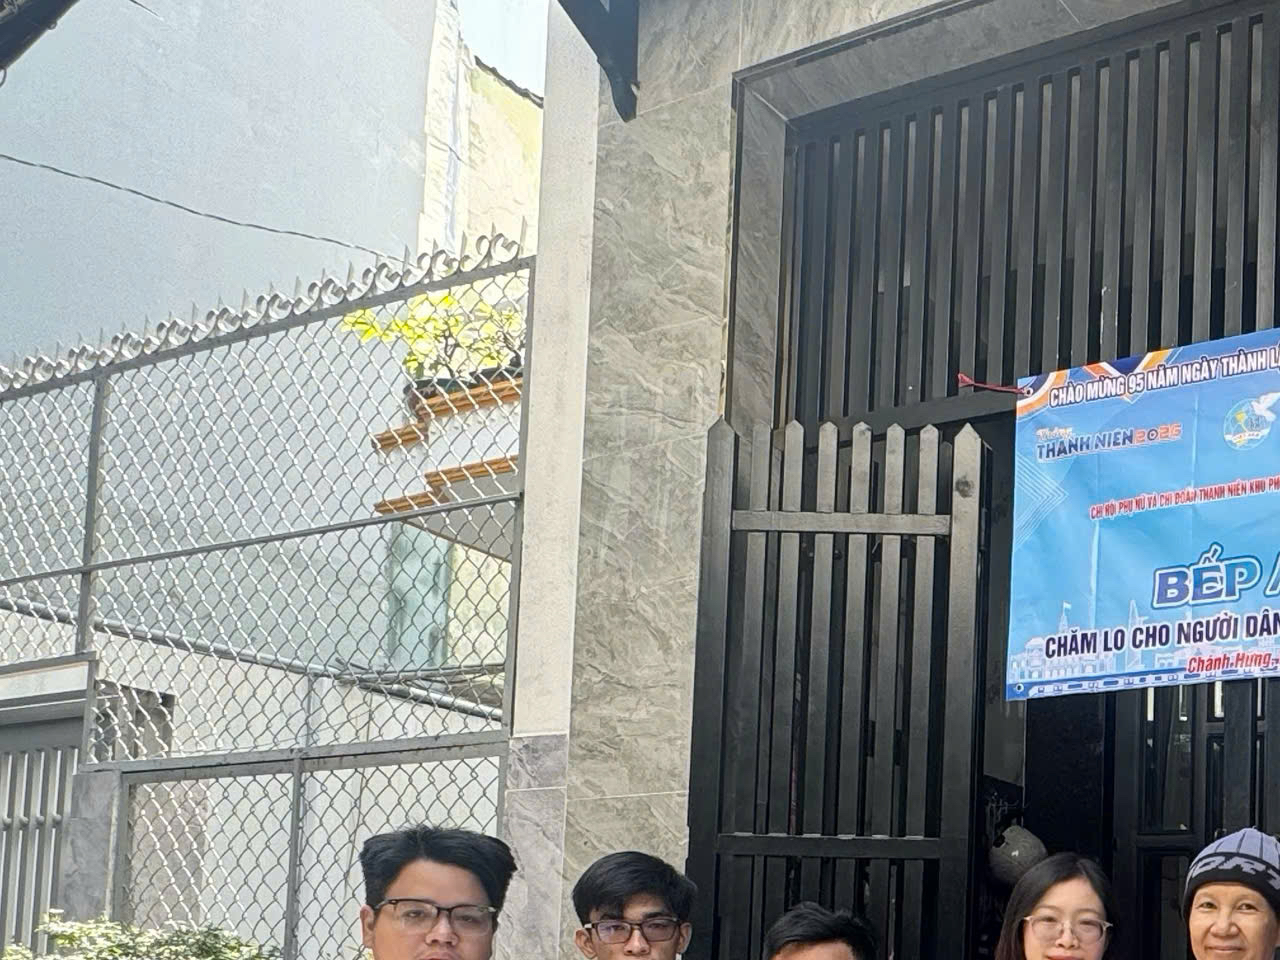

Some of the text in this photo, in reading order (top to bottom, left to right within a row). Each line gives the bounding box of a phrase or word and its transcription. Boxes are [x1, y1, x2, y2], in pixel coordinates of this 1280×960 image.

[1050, 380, 1085, 407] CHÀO
[1128, 373, 1144, 393] 95
[1148, 366, 1178, 389] NĂM
[1182, 357, 1218, 384] NGÀY
[1222, 348, 1267, 377] THÀNH
[1152, 543, 1263, 610] BẾP
[1045, 628, 1097, 659] CHĂM
[1104, 629, 1125, 652] LO
[1132, 624, 1170, 648] CHO
[1178, 612, 1238, 645] NGƯỜI
